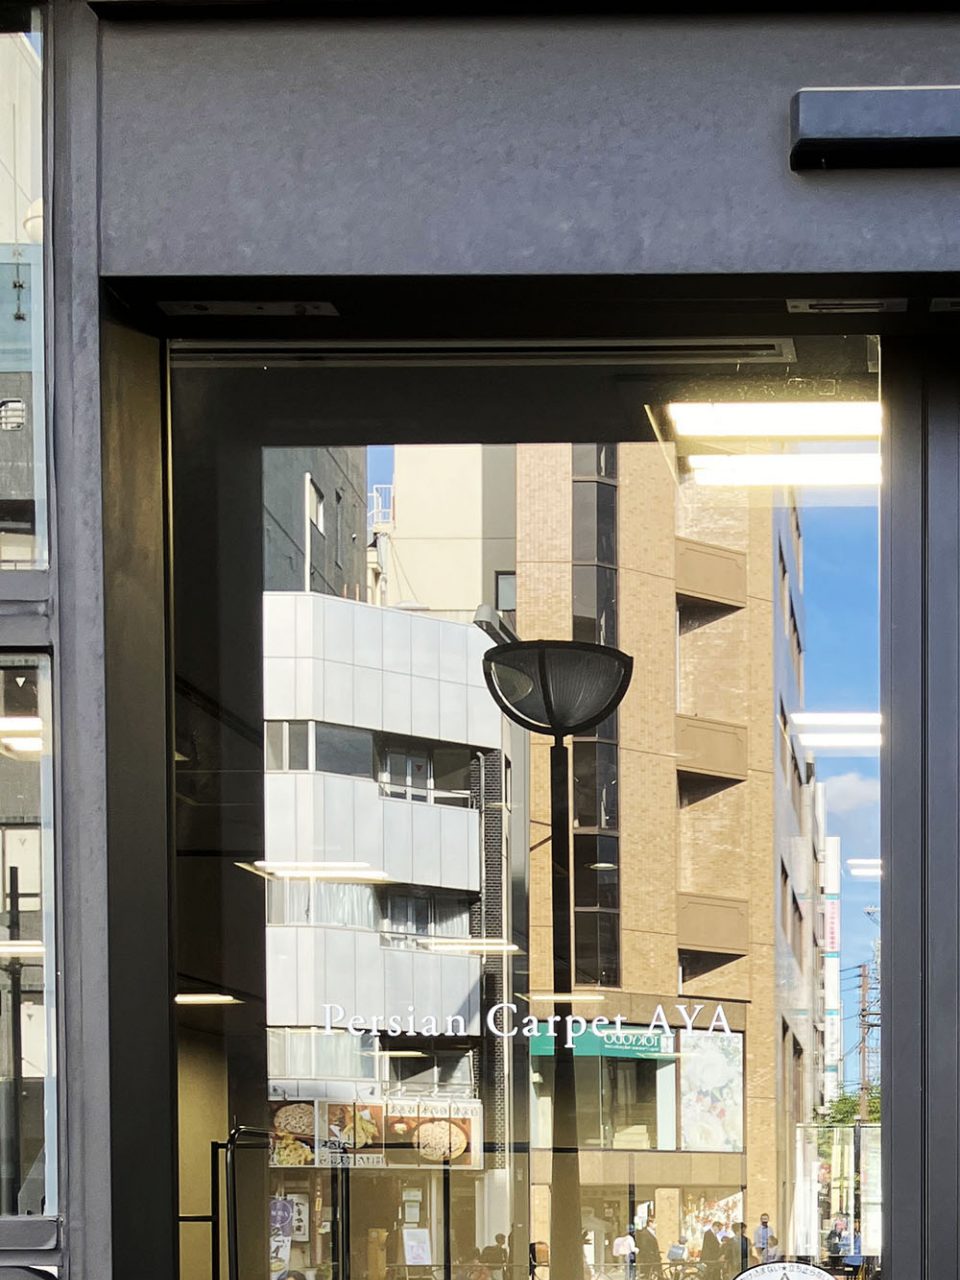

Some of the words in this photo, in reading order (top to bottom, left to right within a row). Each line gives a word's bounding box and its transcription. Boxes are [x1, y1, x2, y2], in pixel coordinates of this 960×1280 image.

[321, 1003, 469, 1037] Persian
[486, 1003, 627, 1048] Carpet
[647, 1003, 734, 1037] AYA
